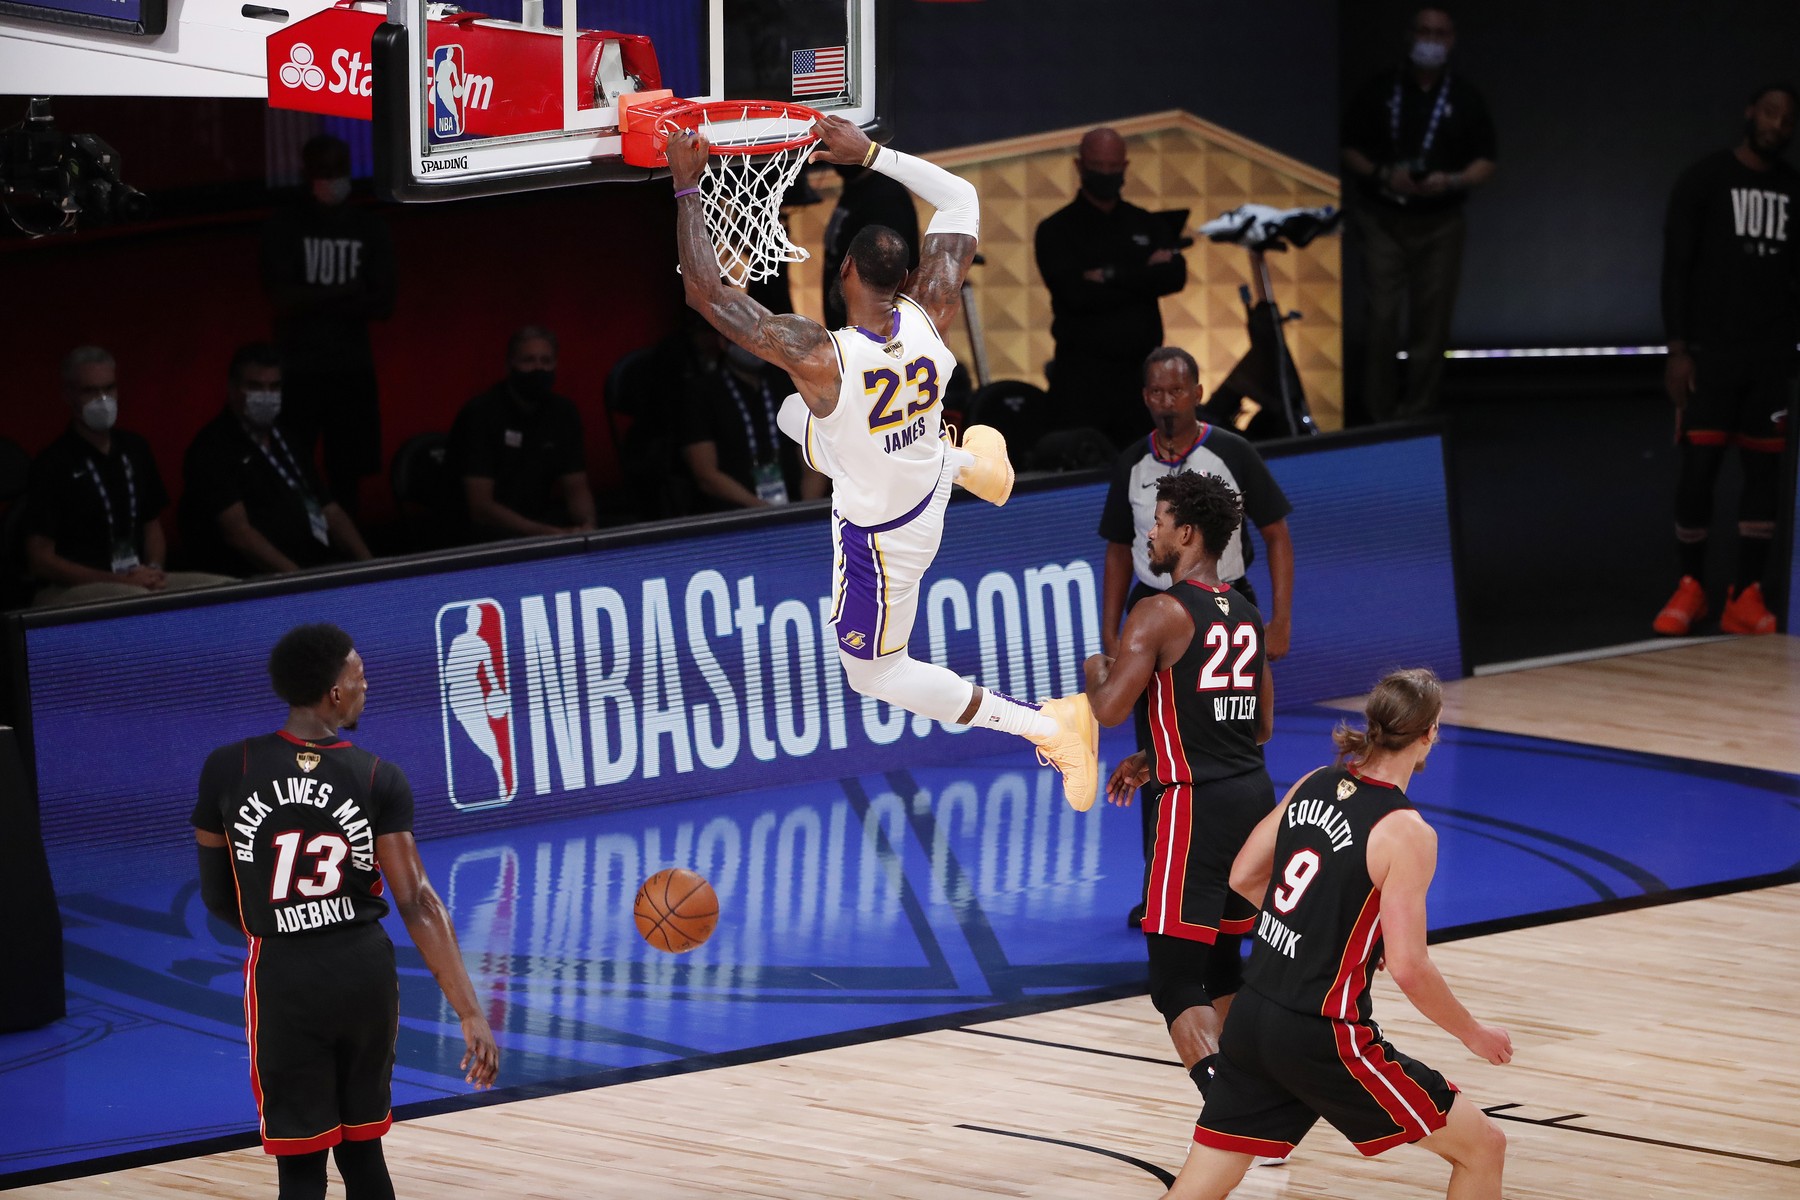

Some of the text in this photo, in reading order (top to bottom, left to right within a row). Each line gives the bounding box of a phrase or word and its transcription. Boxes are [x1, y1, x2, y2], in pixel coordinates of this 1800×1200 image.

[328, 48, 373, 97] Sta
[438, 116, 454, 132] NBA
[421, 156, 468, 174] SPALDING
[1731, 188, 1789, 241] VOTE
[304, 237, 362, 285] VOTE
[862, 355, 940, 435] 23
[884, 416, 926, 454] JAMES
[1196, 621, 1258, 692] 22
[1213, 696, 1257, 721] BUTLER
[234, 777, 374, 872] BLACK LIVES MATTER
[1287, 799, 1353, 852] EQUALITY
[269, 830, 350, 903] 13
[1274, 847, 1321, 915] 9
[275, 897, 356, 933] ADEBAYO
[1257, 910, 1302, 959] OLYNYK
